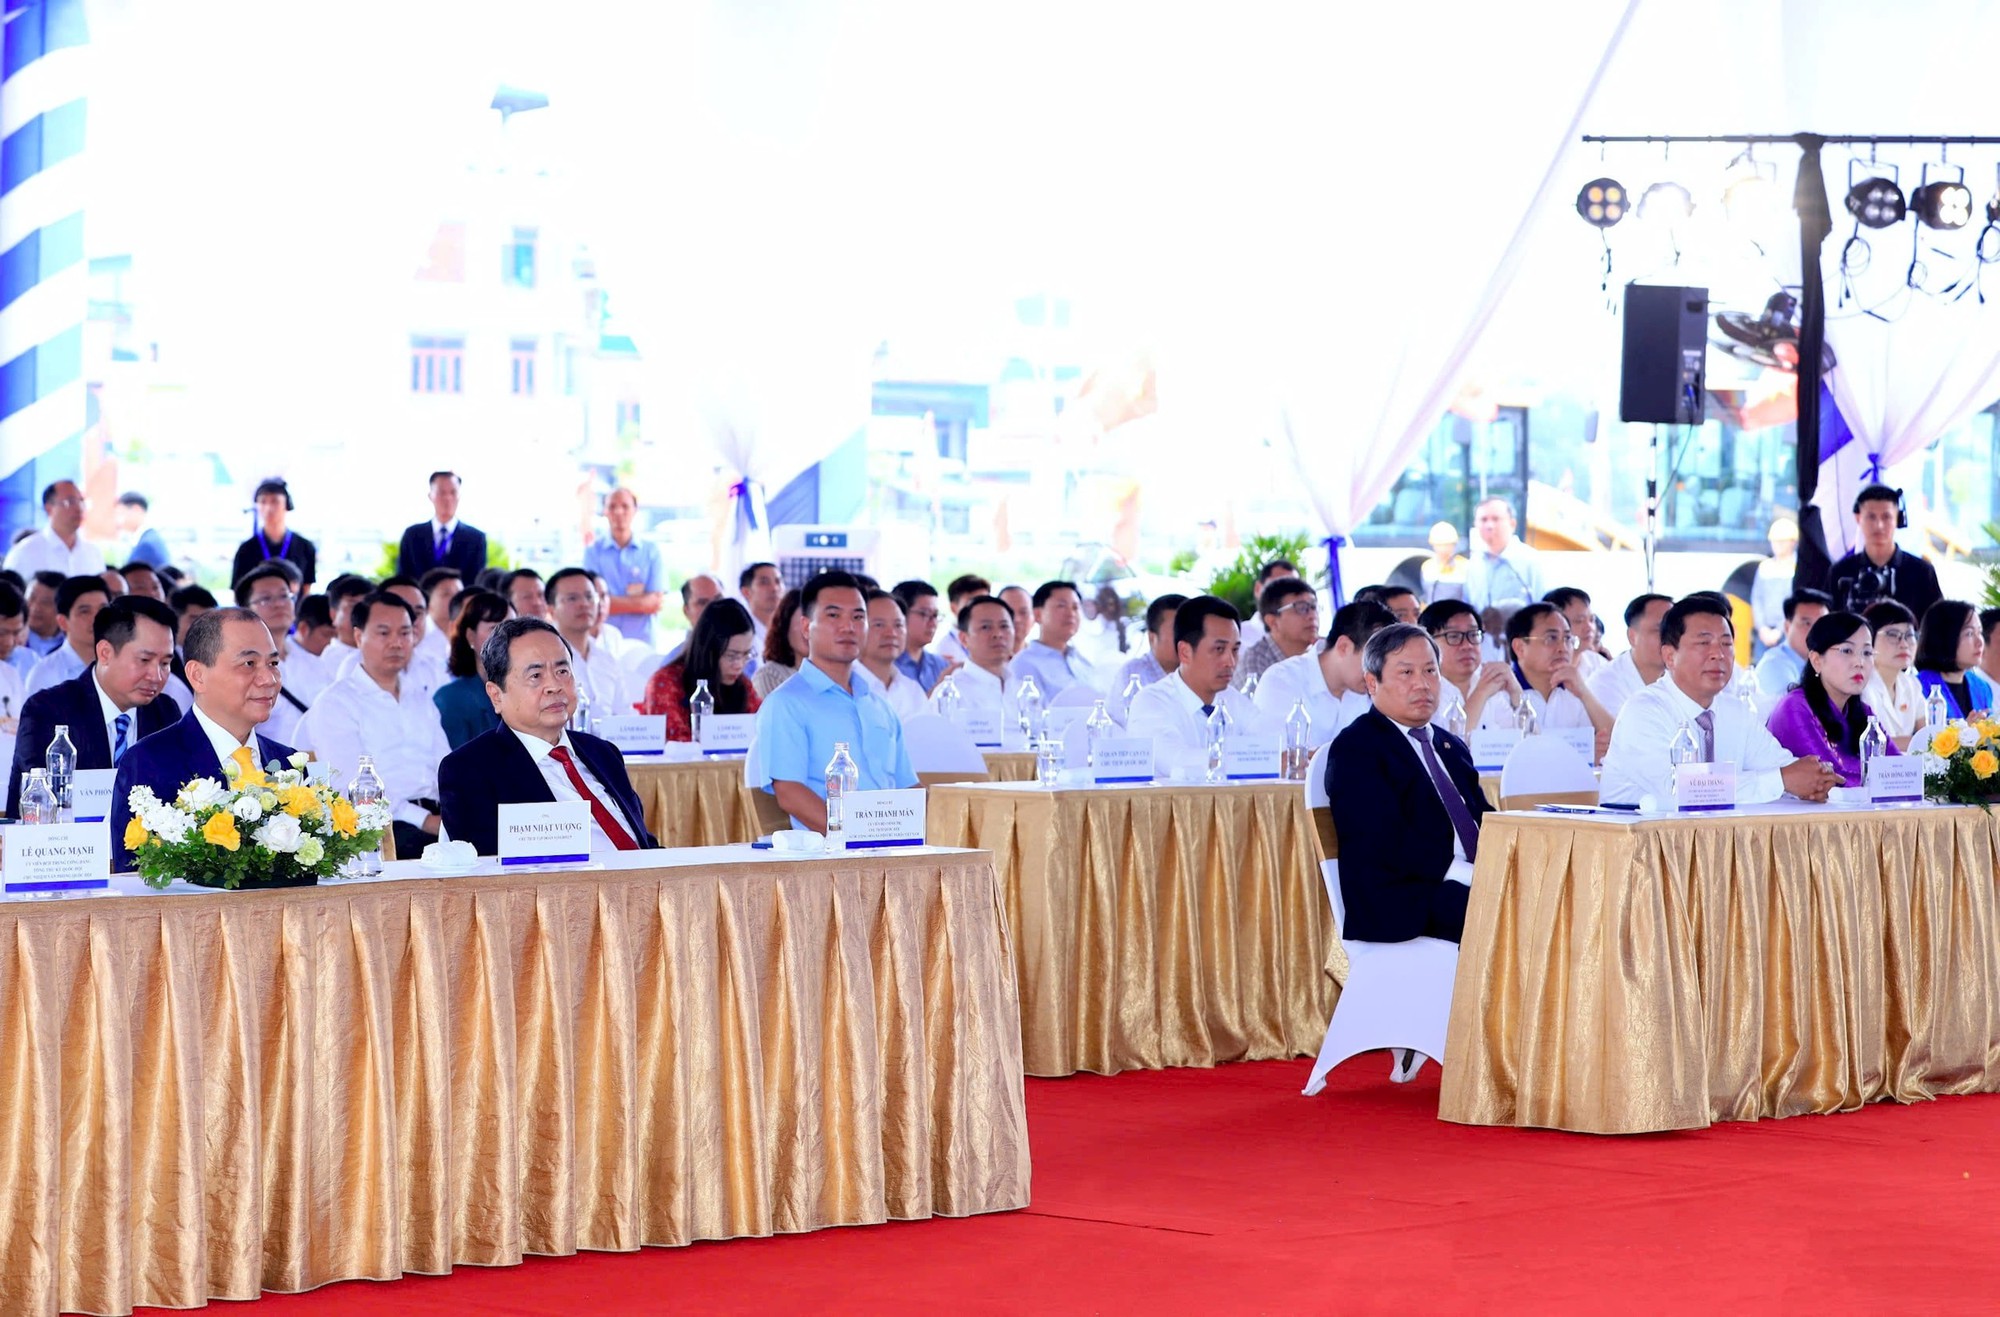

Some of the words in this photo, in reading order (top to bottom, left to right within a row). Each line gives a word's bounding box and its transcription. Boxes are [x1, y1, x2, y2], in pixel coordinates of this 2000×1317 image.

[94, 787, 112, 796] PHÒN
[855, 808, 873, 818] TRẦN
[875, 810, 898, 818] THANH
[509, 824, 531, 834] PHẠM
[533, 823, 554, 834] NHẬT
[554, 822, 582, 832] VƯỢNG
[22, 846, 32, 857] LÊ
[34, 847, 66, 858] QUANG
[68, 846, 94, 857] MẠNH
